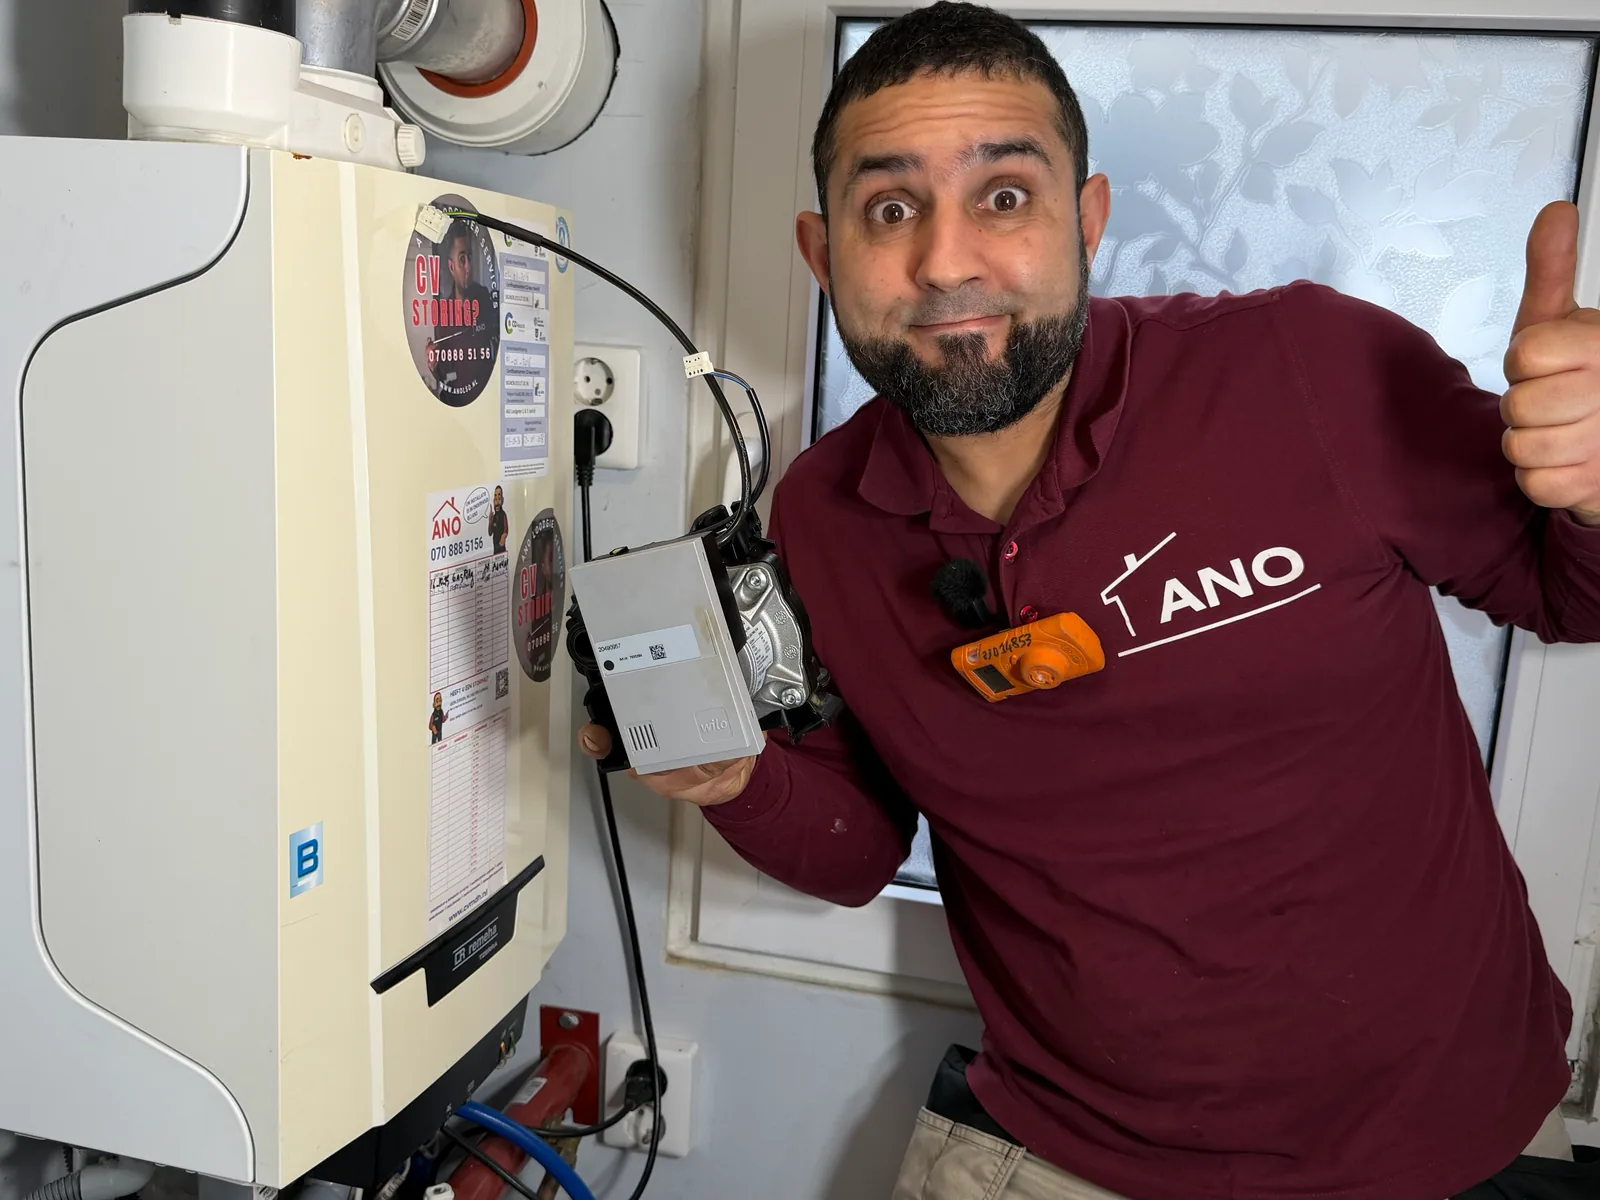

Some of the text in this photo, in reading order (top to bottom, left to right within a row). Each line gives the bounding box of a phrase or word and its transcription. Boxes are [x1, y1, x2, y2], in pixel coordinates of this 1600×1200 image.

[415, 254, 440, 296] CV
[412, 298, 480, 327] STORING?
[428, 347, 491, 362] 070888 51 56
[432, 516, 461, 540] ANO
[430, 536, 484, 561] 070 888 5156
[519, 563, 537, 600] CV
[1160, 546, 1305, 624] ANO
[700, 718, 729, 733] wilo
[297, 838, 319, 879] B
[468, 924, 497, 955] remeha
